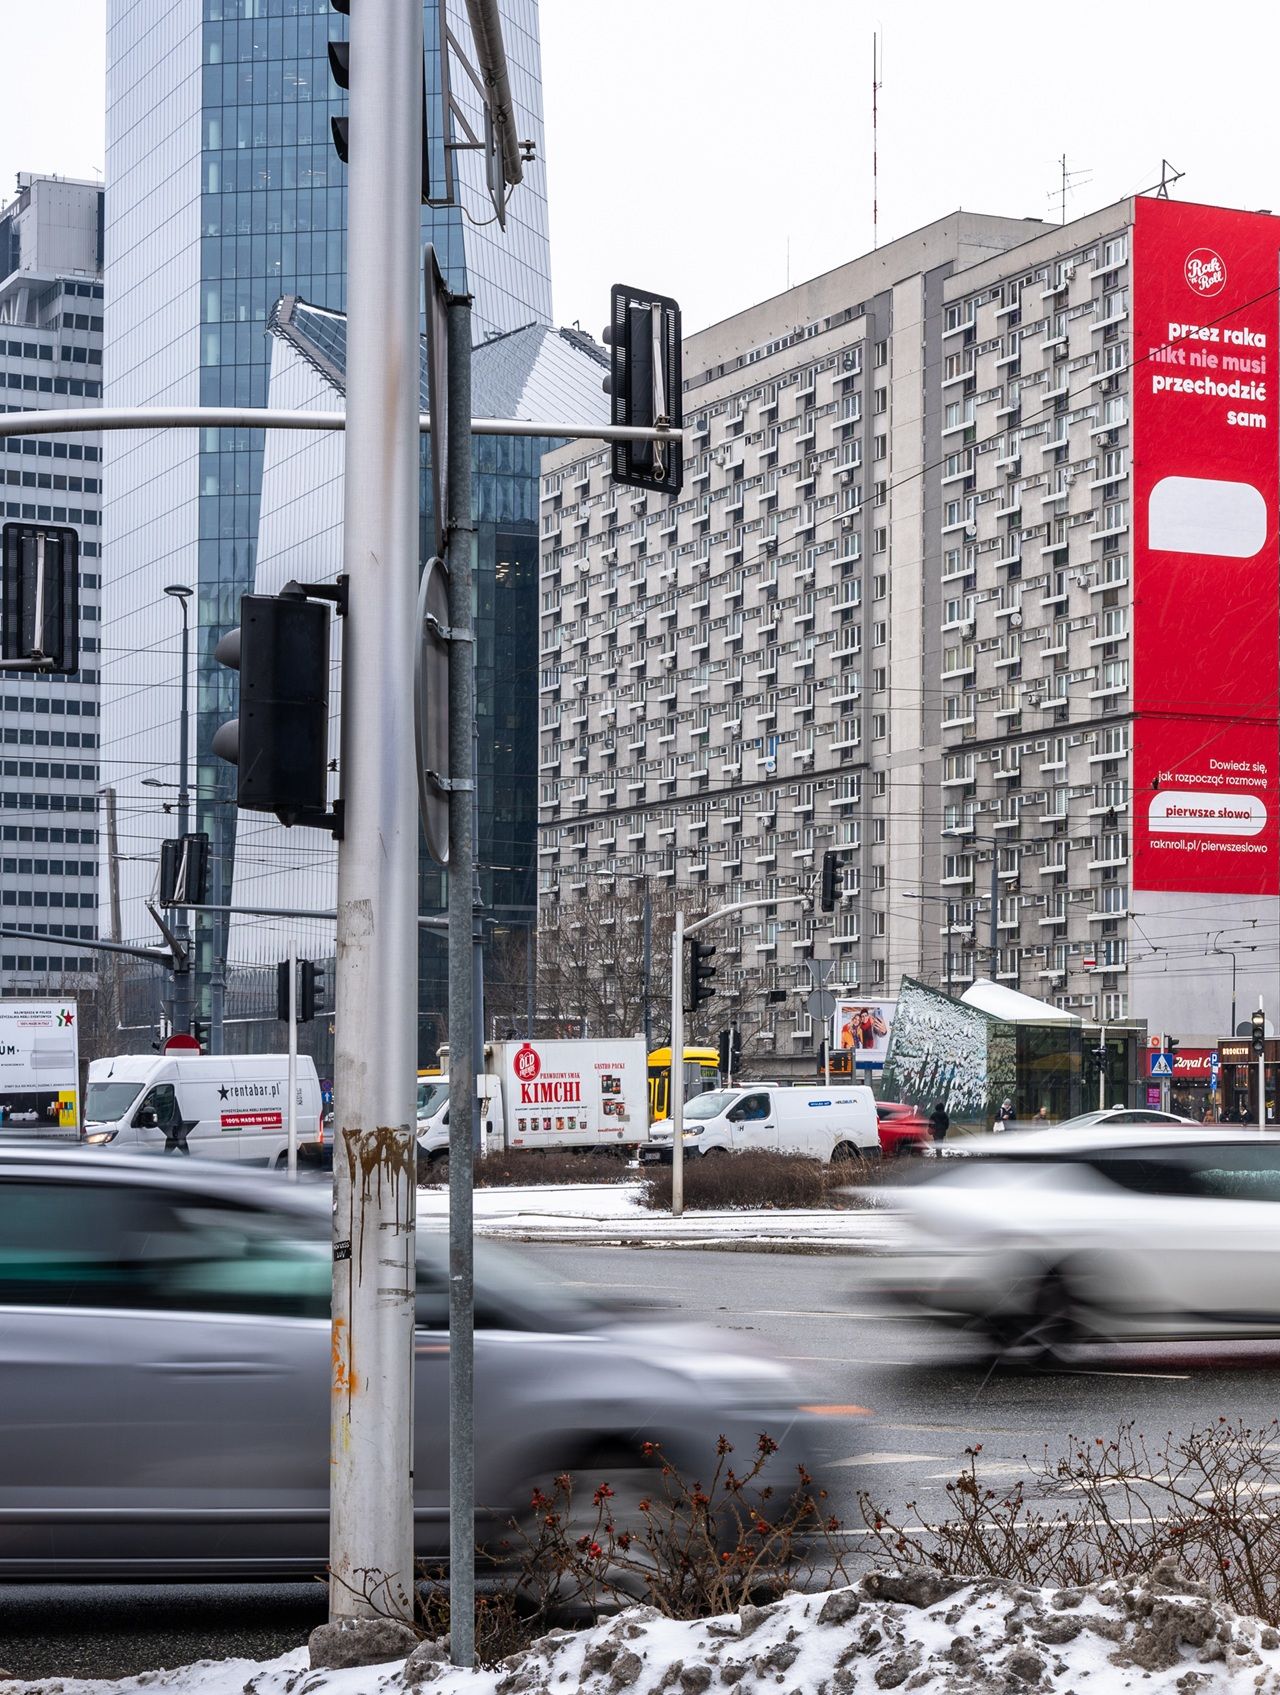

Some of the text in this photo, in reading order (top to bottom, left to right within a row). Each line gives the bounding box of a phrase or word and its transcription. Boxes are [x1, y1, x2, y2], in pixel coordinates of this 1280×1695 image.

[1188, 257, 1221, 277] Rak
[1198, 271, 1224, 290] Roll
[1168, 322, 1266, 348] przez raka
[1149, 344, 1266, 375] nikt nie musi
[1152, 374, 1266, 401] przechodzić
[1227, 410, 1266, 428] sam
[1209, 758, 1268, 774] Dowiedz się,
[1158, 771, 1268, 789] jak rozpocząć rozmowę
[1166, 805, 1250, 820] pierwsze słowo
[1150, 838, 1268, 853] raknroll.pl/pierwszeslowo
[1222, 1047, 1249, 1055] BROOKLYN
[519, 1053, 535, 1070] OLD
[1174, 1056, 1202, 1070] Royal
[230, 1083, 280, 1098] rentabar.pl
[520, 1082, 581, 1104] KIMCHI
